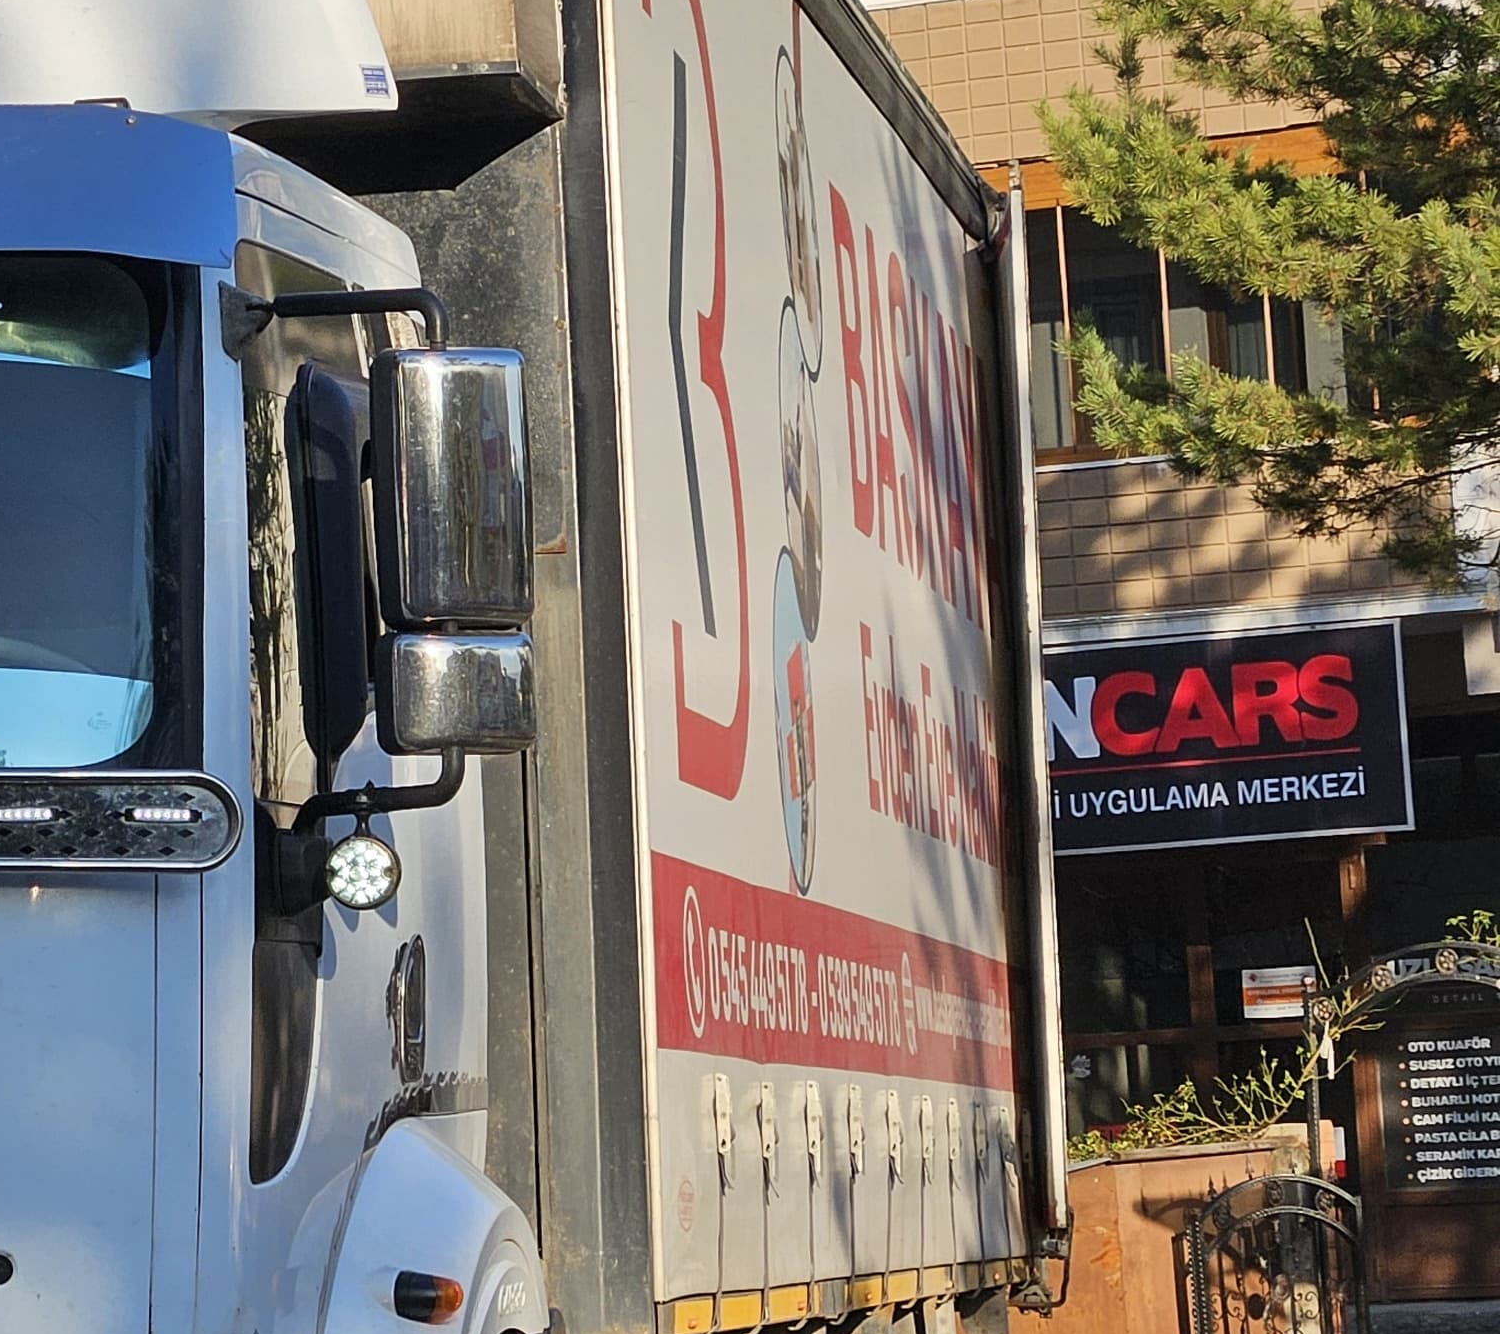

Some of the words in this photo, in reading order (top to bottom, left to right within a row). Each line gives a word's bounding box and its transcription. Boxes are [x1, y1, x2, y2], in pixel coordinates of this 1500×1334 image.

[860, 620, 926, 833] Evden
[920, 663, 957, 848] Eve
[1070, 781, 1230, 818] UYGULAMA
[1237, 766, 1366, 806] MERKEZİ
[1407, 1041, 1435, 1053] OTO
[1436, 1036, 1491, 1052] KUAFÖR
[1408, 1058, 1454, 1072] SUSUZ
[1455, 1057, 1483, 1068] OTO
[1410, 1077, 1463, 1089] DETAYLI
[1465, 1073, 1479, 1089] İÇ
[1411, 1094, 1470, 1107] BUHARLI
[1412, 1114, 1443, 1126] CAM
[1414, 1132, 1458, 1144] PASTA
[1458, 1129, 1490, 1142] CİLA
[1415, 1147, 1476, 1162] SERAMİK
[1417, 1167, 1453, 1183] ÇİZİK
